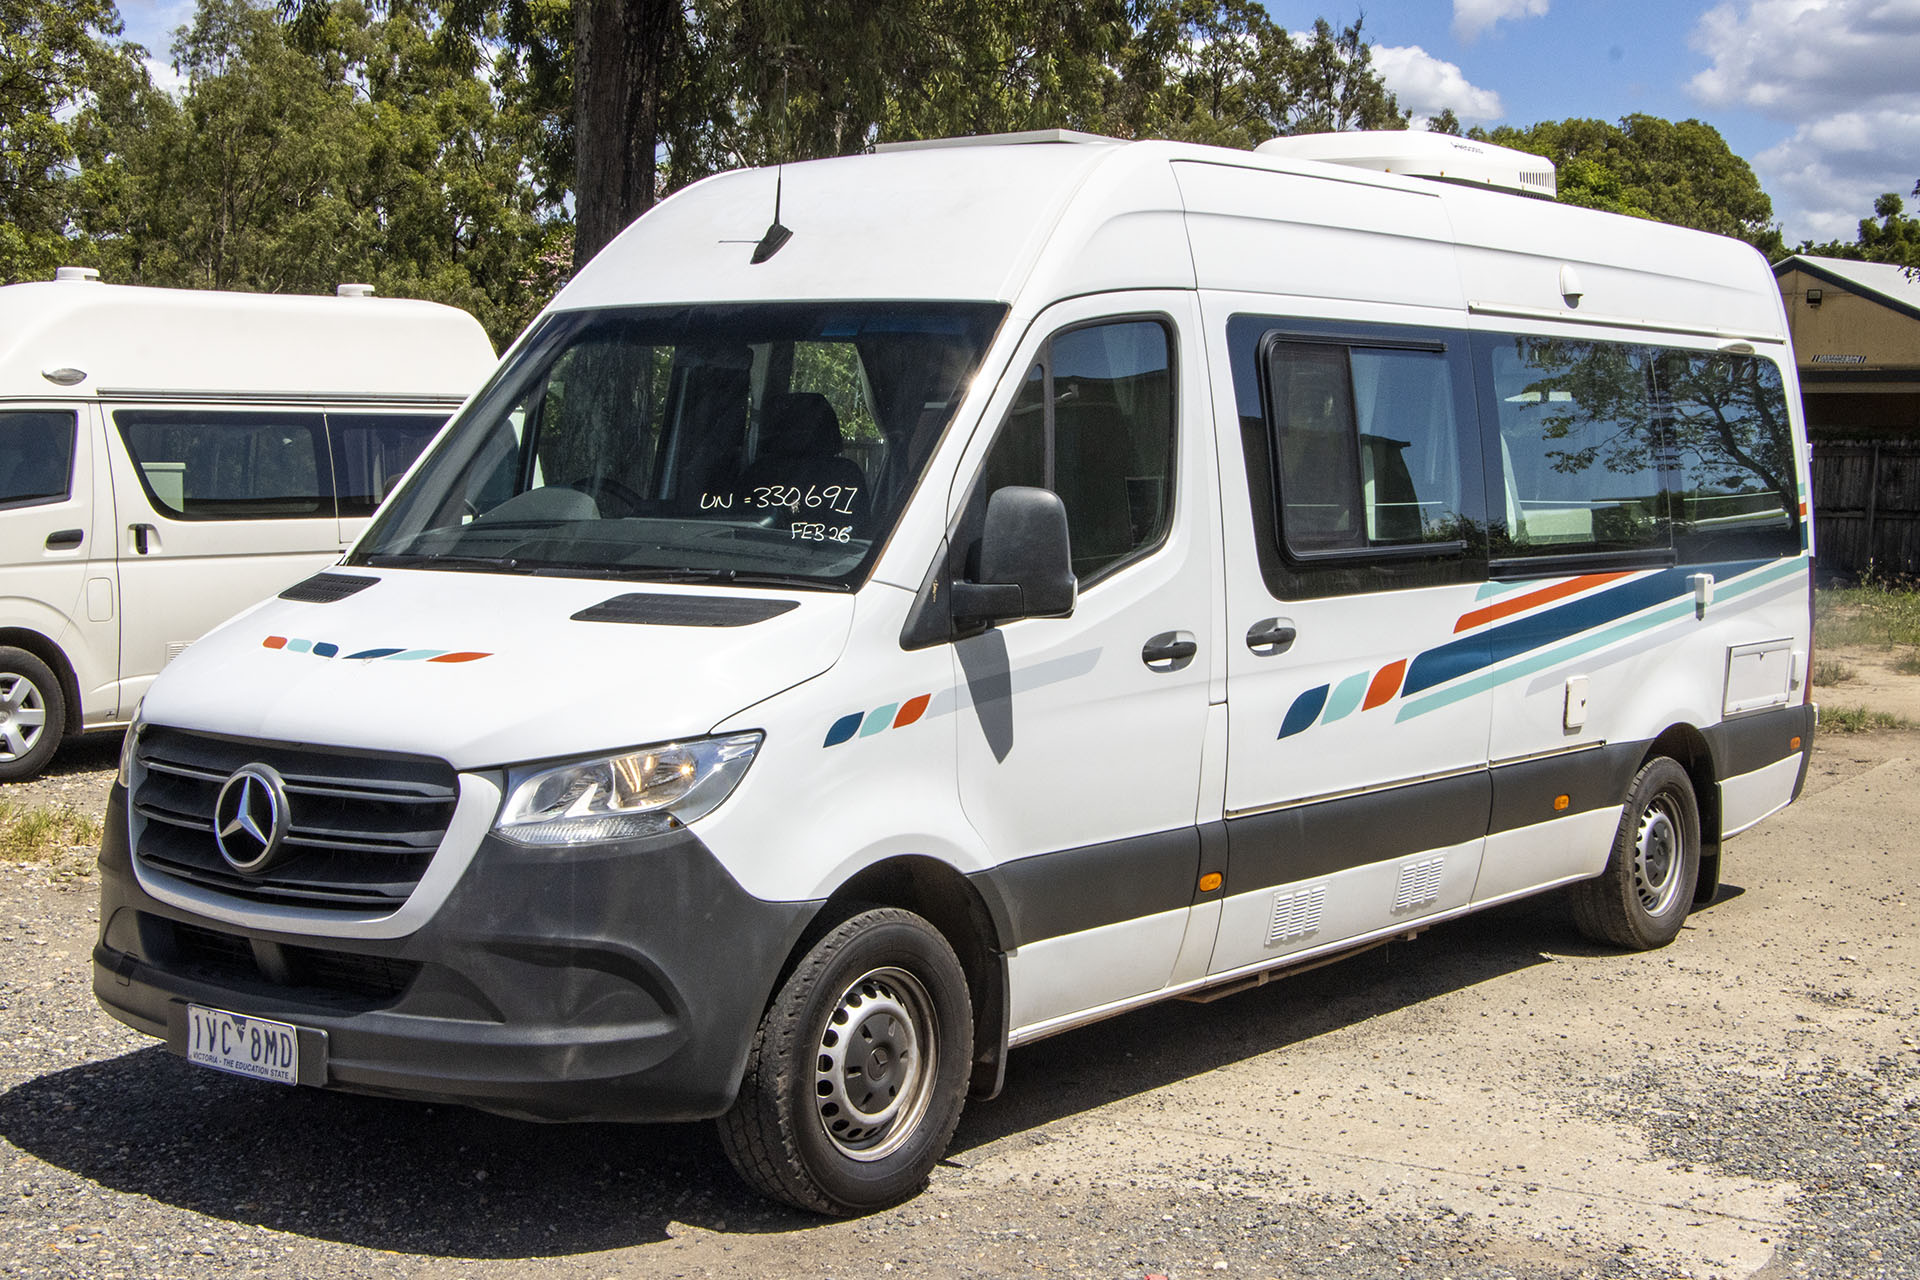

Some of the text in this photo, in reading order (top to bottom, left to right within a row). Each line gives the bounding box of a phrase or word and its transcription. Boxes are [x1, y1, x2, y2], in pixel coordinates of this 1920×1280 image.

[791, 522, 825, 541] FEB
[193, 1051, 218, 1064] VICTORIA
[223, 1058, 235, 1068] THE
[235, 1061, 269, 1075] EDUCATION
[270, 1068, 289, 1079] STATE
